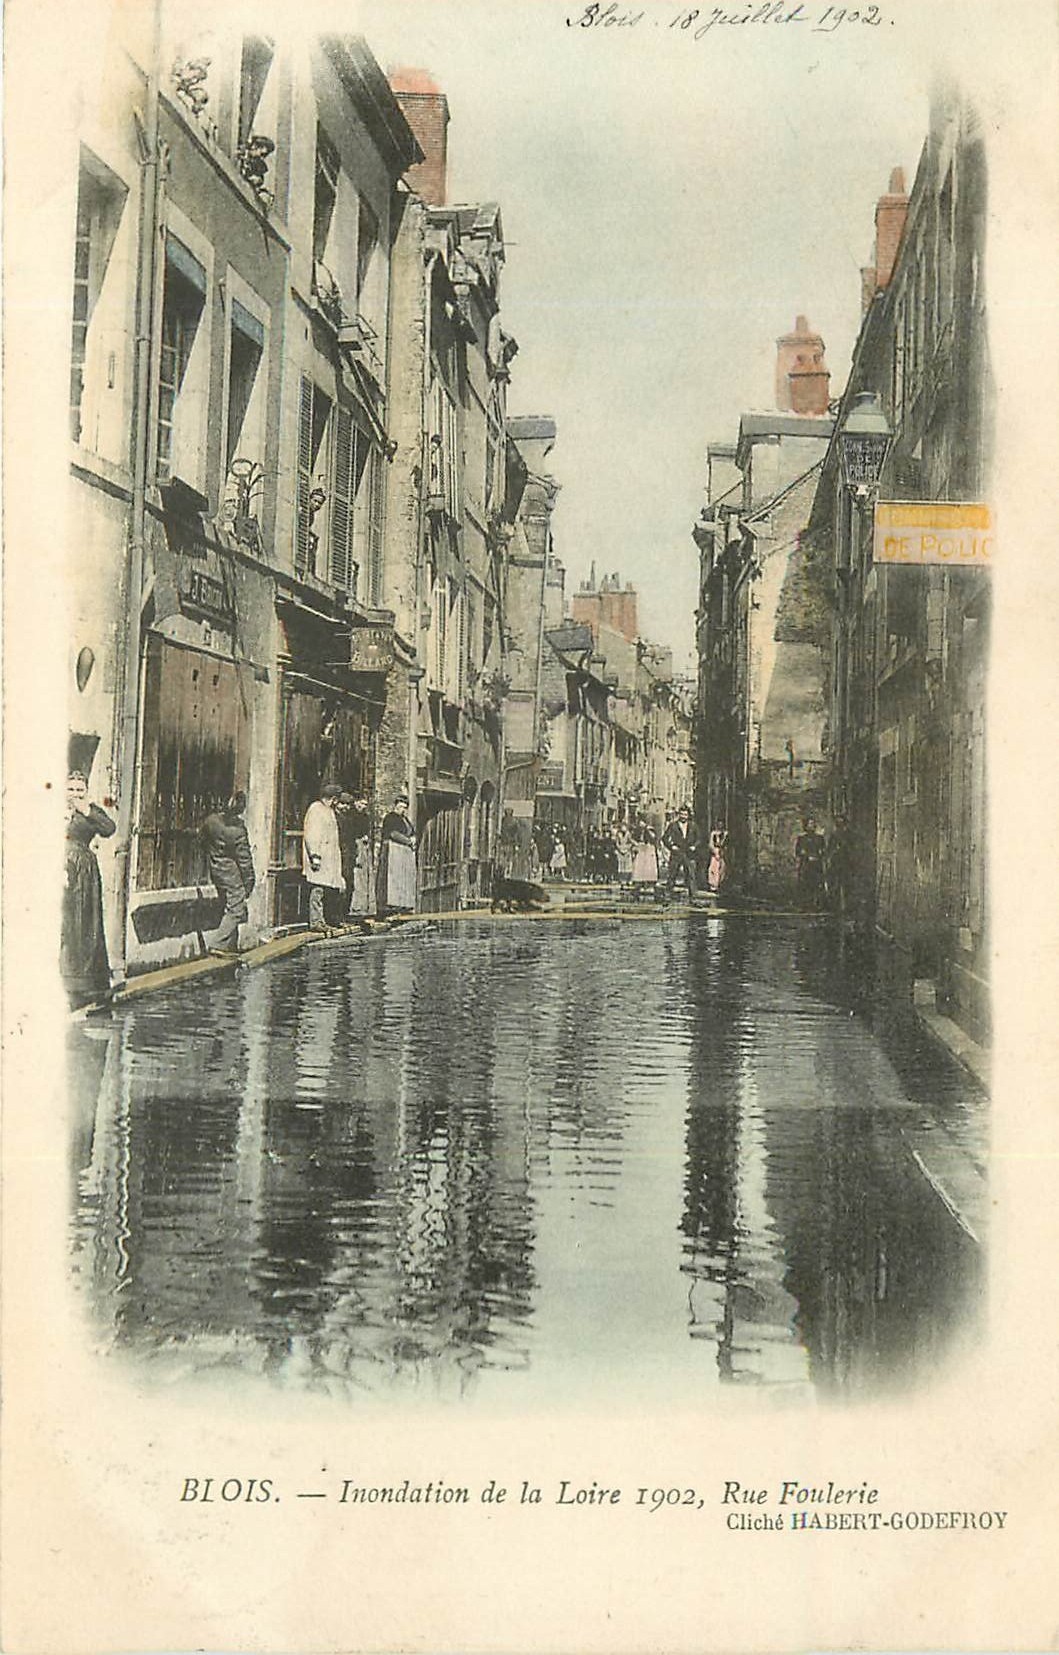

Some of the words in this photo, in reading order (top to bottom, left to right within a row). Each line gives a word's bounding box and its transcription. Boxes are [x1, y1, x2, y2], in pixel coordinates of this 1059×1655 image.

[669, 9, 701, 30] 18
[695, 2, 810, 40] Juillet
[883, 535, 912, 558] DE
